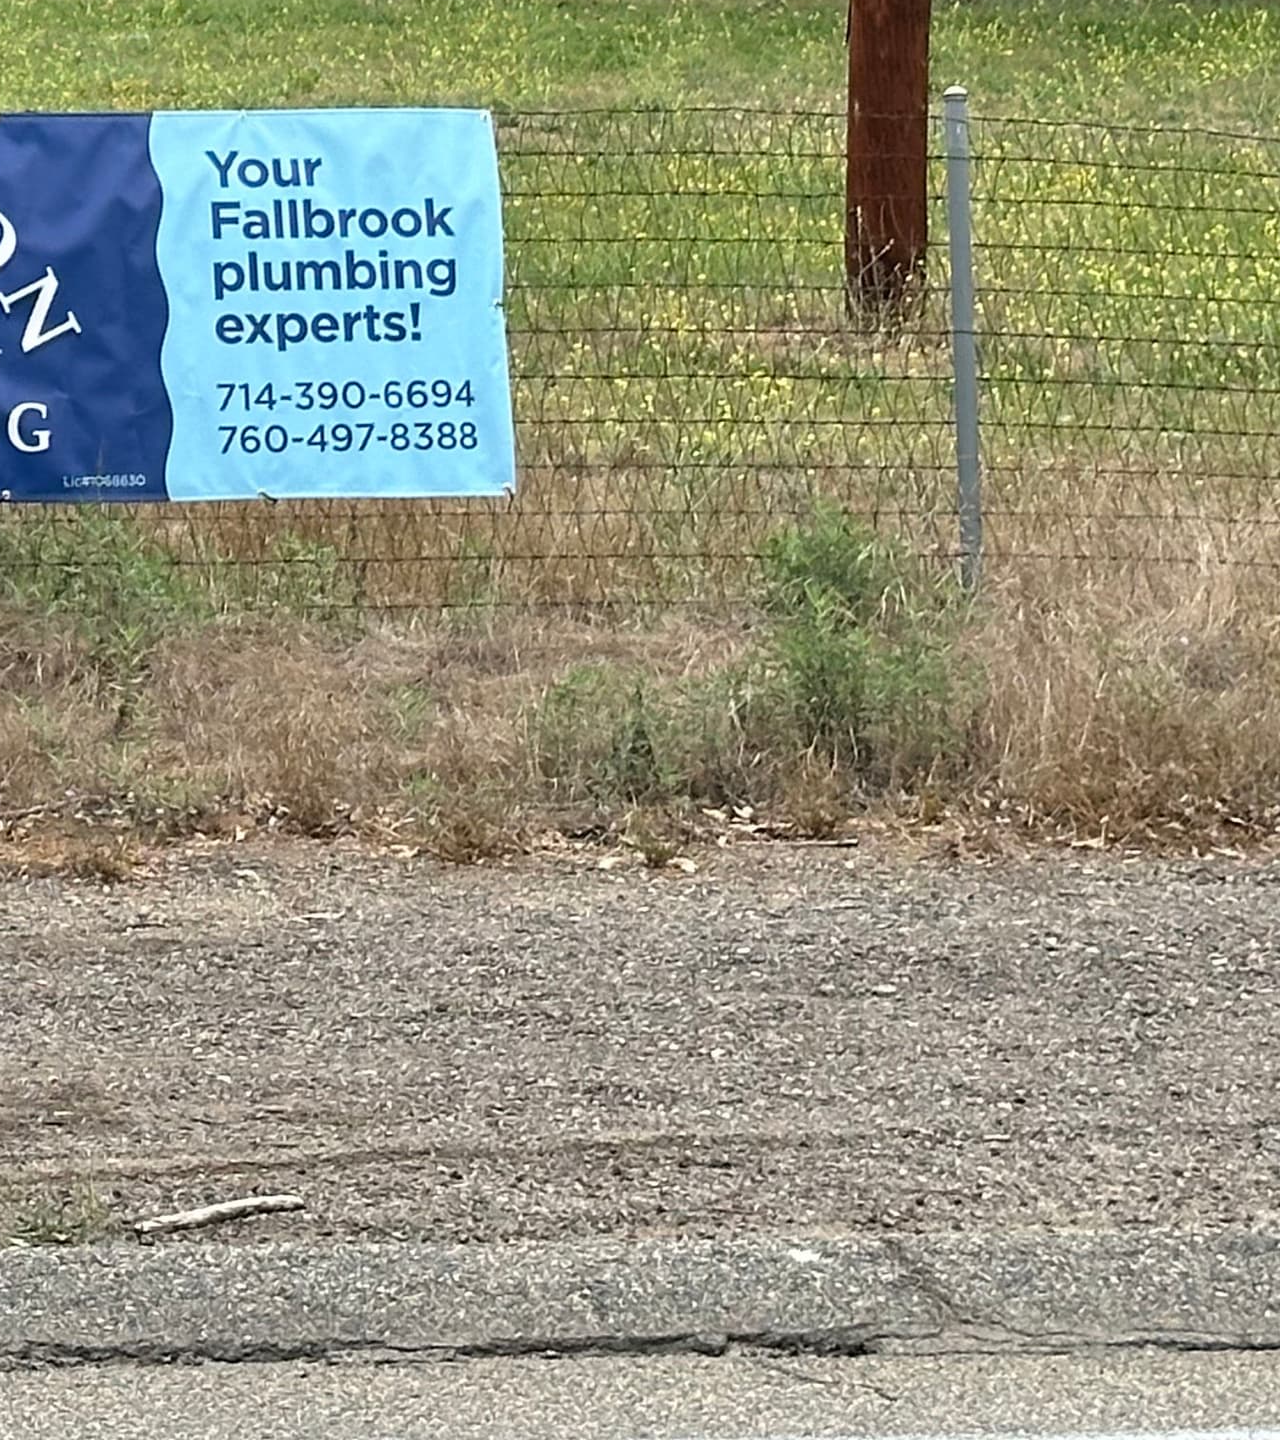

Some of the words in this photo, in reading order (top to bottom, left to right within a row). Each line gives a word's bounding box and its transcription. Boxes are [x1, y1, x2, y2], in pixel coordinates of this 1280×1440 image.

[205, 150, 322, 188] Your
[211, 198, 454, 240] Fallbrook
[214, 250, 456, 300] plumbing
[215, 303, 422, 351] experts!
[216, 380, 475, 411] 714-390-6694
[218, 422, 477, 454] 760-497-8388
